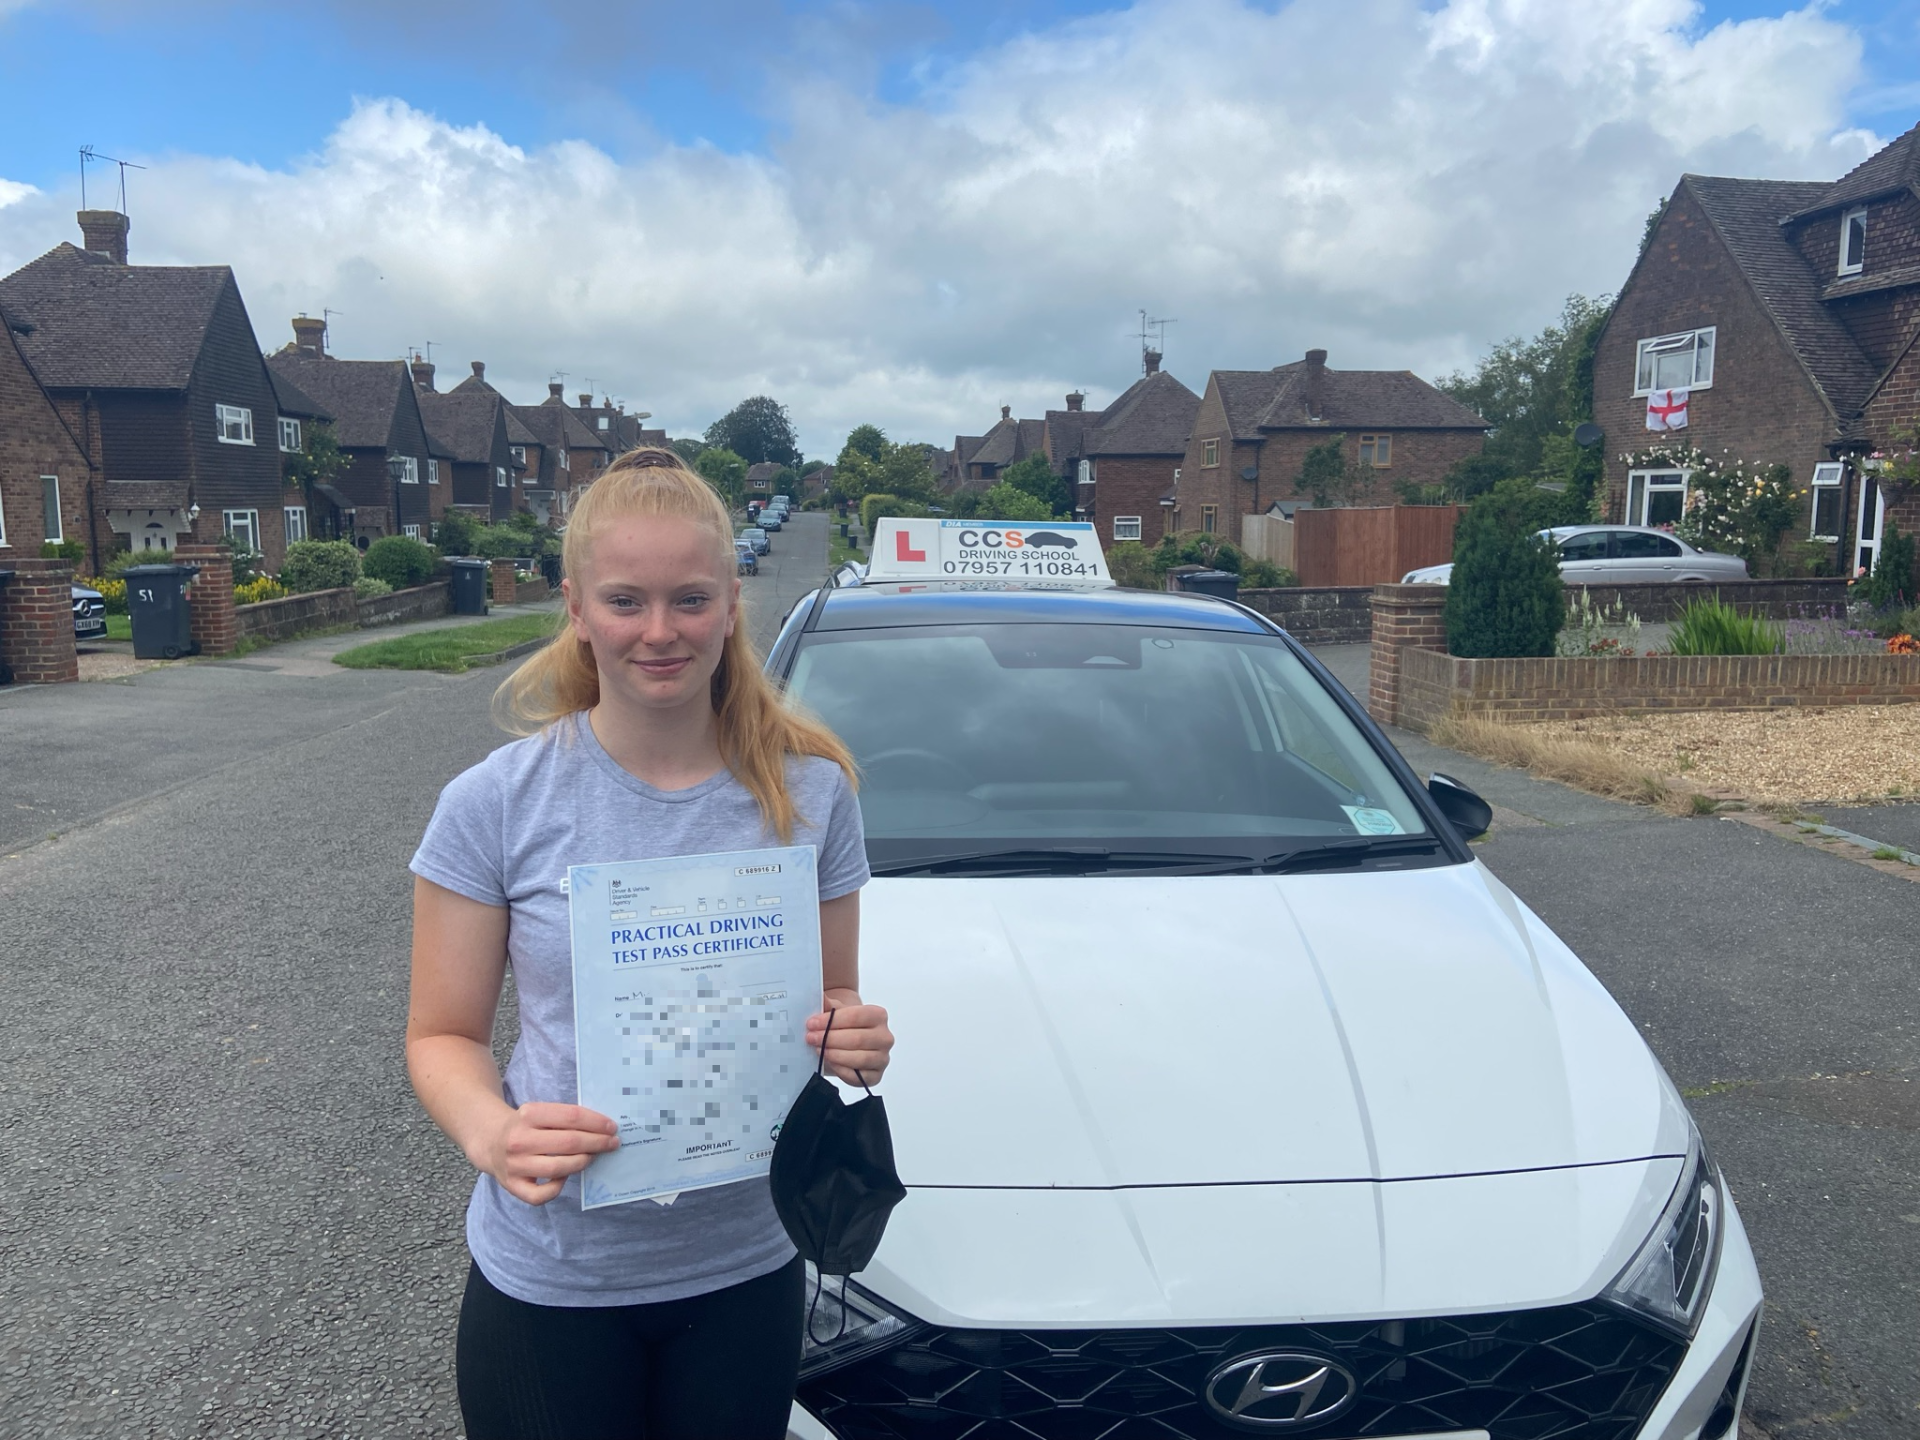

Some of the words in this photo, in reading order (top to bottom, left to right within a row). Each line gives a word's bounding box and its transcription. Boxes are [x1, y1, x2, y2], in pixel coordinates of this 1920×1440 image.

[896, 531, 926, 562] L
[958, 530, 1025, 549] CCS
[959, 550, 1018, 560] DRIVING
[1021, 550, 1080, 561] SCHOOL
[943, 561, 1012, 574] 07957
[1020, 562, 1098, 576] 110841
[139, 589, 154, 603] 51
[745, 866, 770, 874] 689916
[611, 922, 705, 945] PRACTICAL
[709, 913, 784, 935] DRIVING
[612, 948, 648, 964] TEST
[653, 944, 688, 960] PASS
[693, 933, 785, 956] CERTIFICATE
[686, 1140, 734, 1154] IMPORTANT
[756, 1150, 772, 1159] 6899
